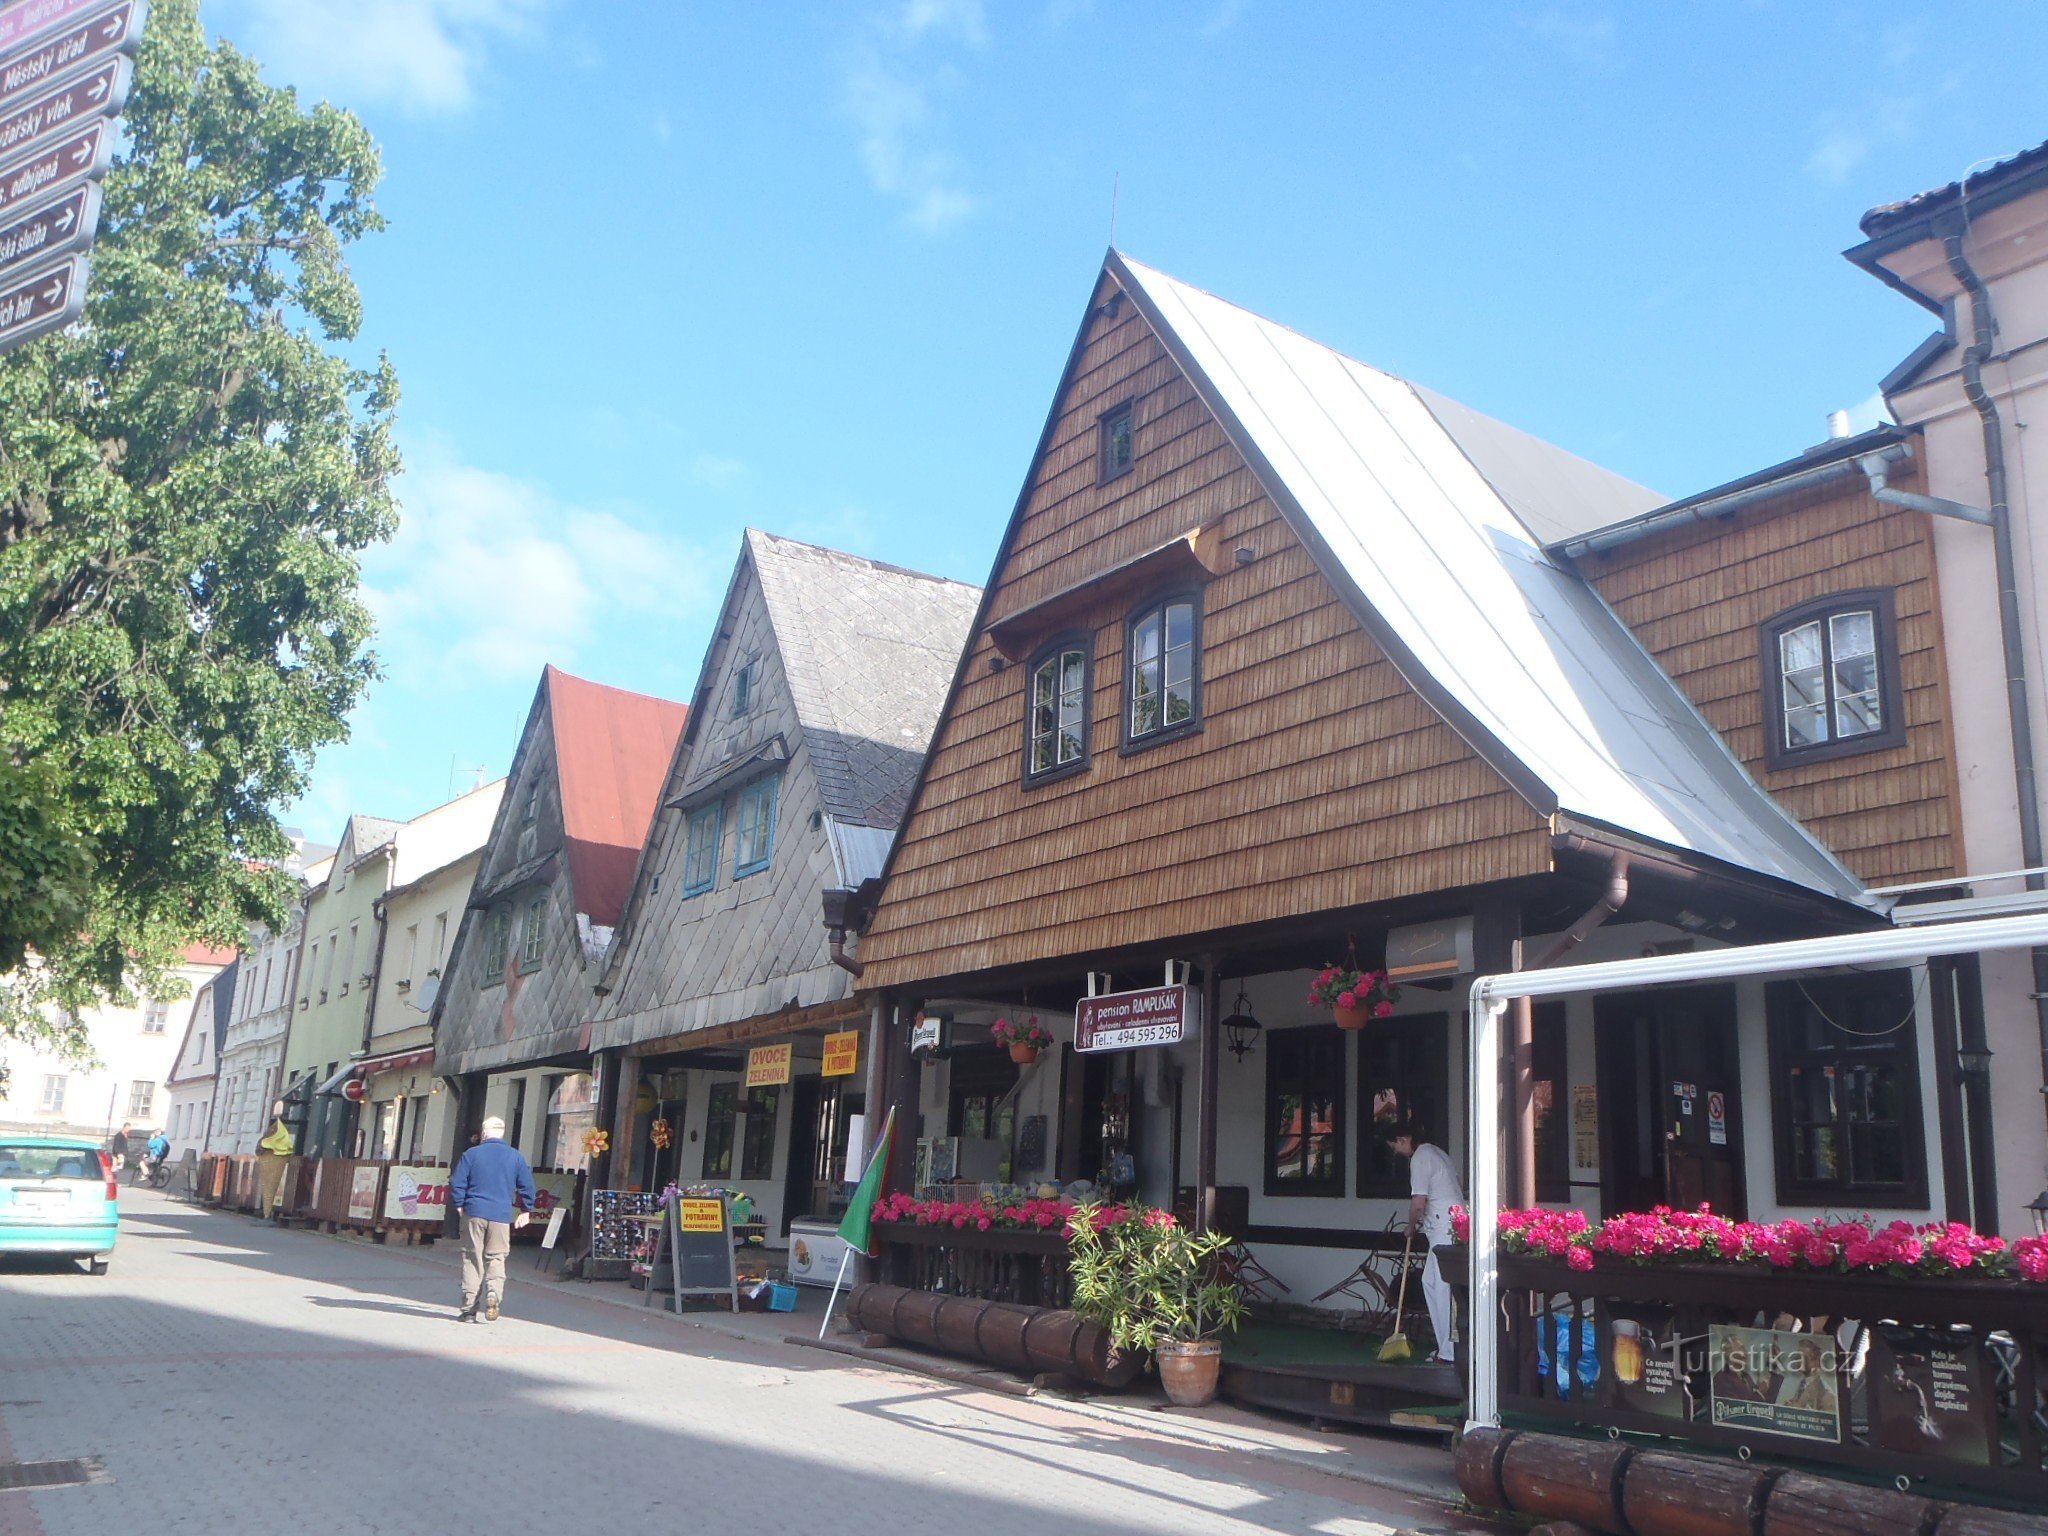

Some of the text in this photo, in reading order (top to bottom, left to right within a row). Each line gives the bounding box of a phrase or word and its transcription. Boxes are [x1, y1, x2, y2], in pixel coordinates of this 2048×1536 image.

[3, 30, 88, 93] Městský úřad
[46, 92, 73, 124] vlek
[16, 222, 47, 255] služba
[15, 294, 35, 320] hor
[1097, 991, 1176, 1021] pension RAMPUŠÁK
[1095, 1024, 1178, 1046] Tel.: 494 595 296
[751, 1047, 788, 1066] OVOCE
[748, 1067, 785, 1083] ZELENINA
[685, 1213, 718, 1221] POTRAVINY
[1645, 1358, 1654, 1366] Co
[1931, 1350, 1957, 1362] Kdo je
[1651, 1377, 1672, 1386] obsahu
[1932, 1370, 1952, 1379] tomu
[1934, 1390, 1956, 1400] dojde
[1716, 1401, 1775, 1421] Pilsner Urquell
